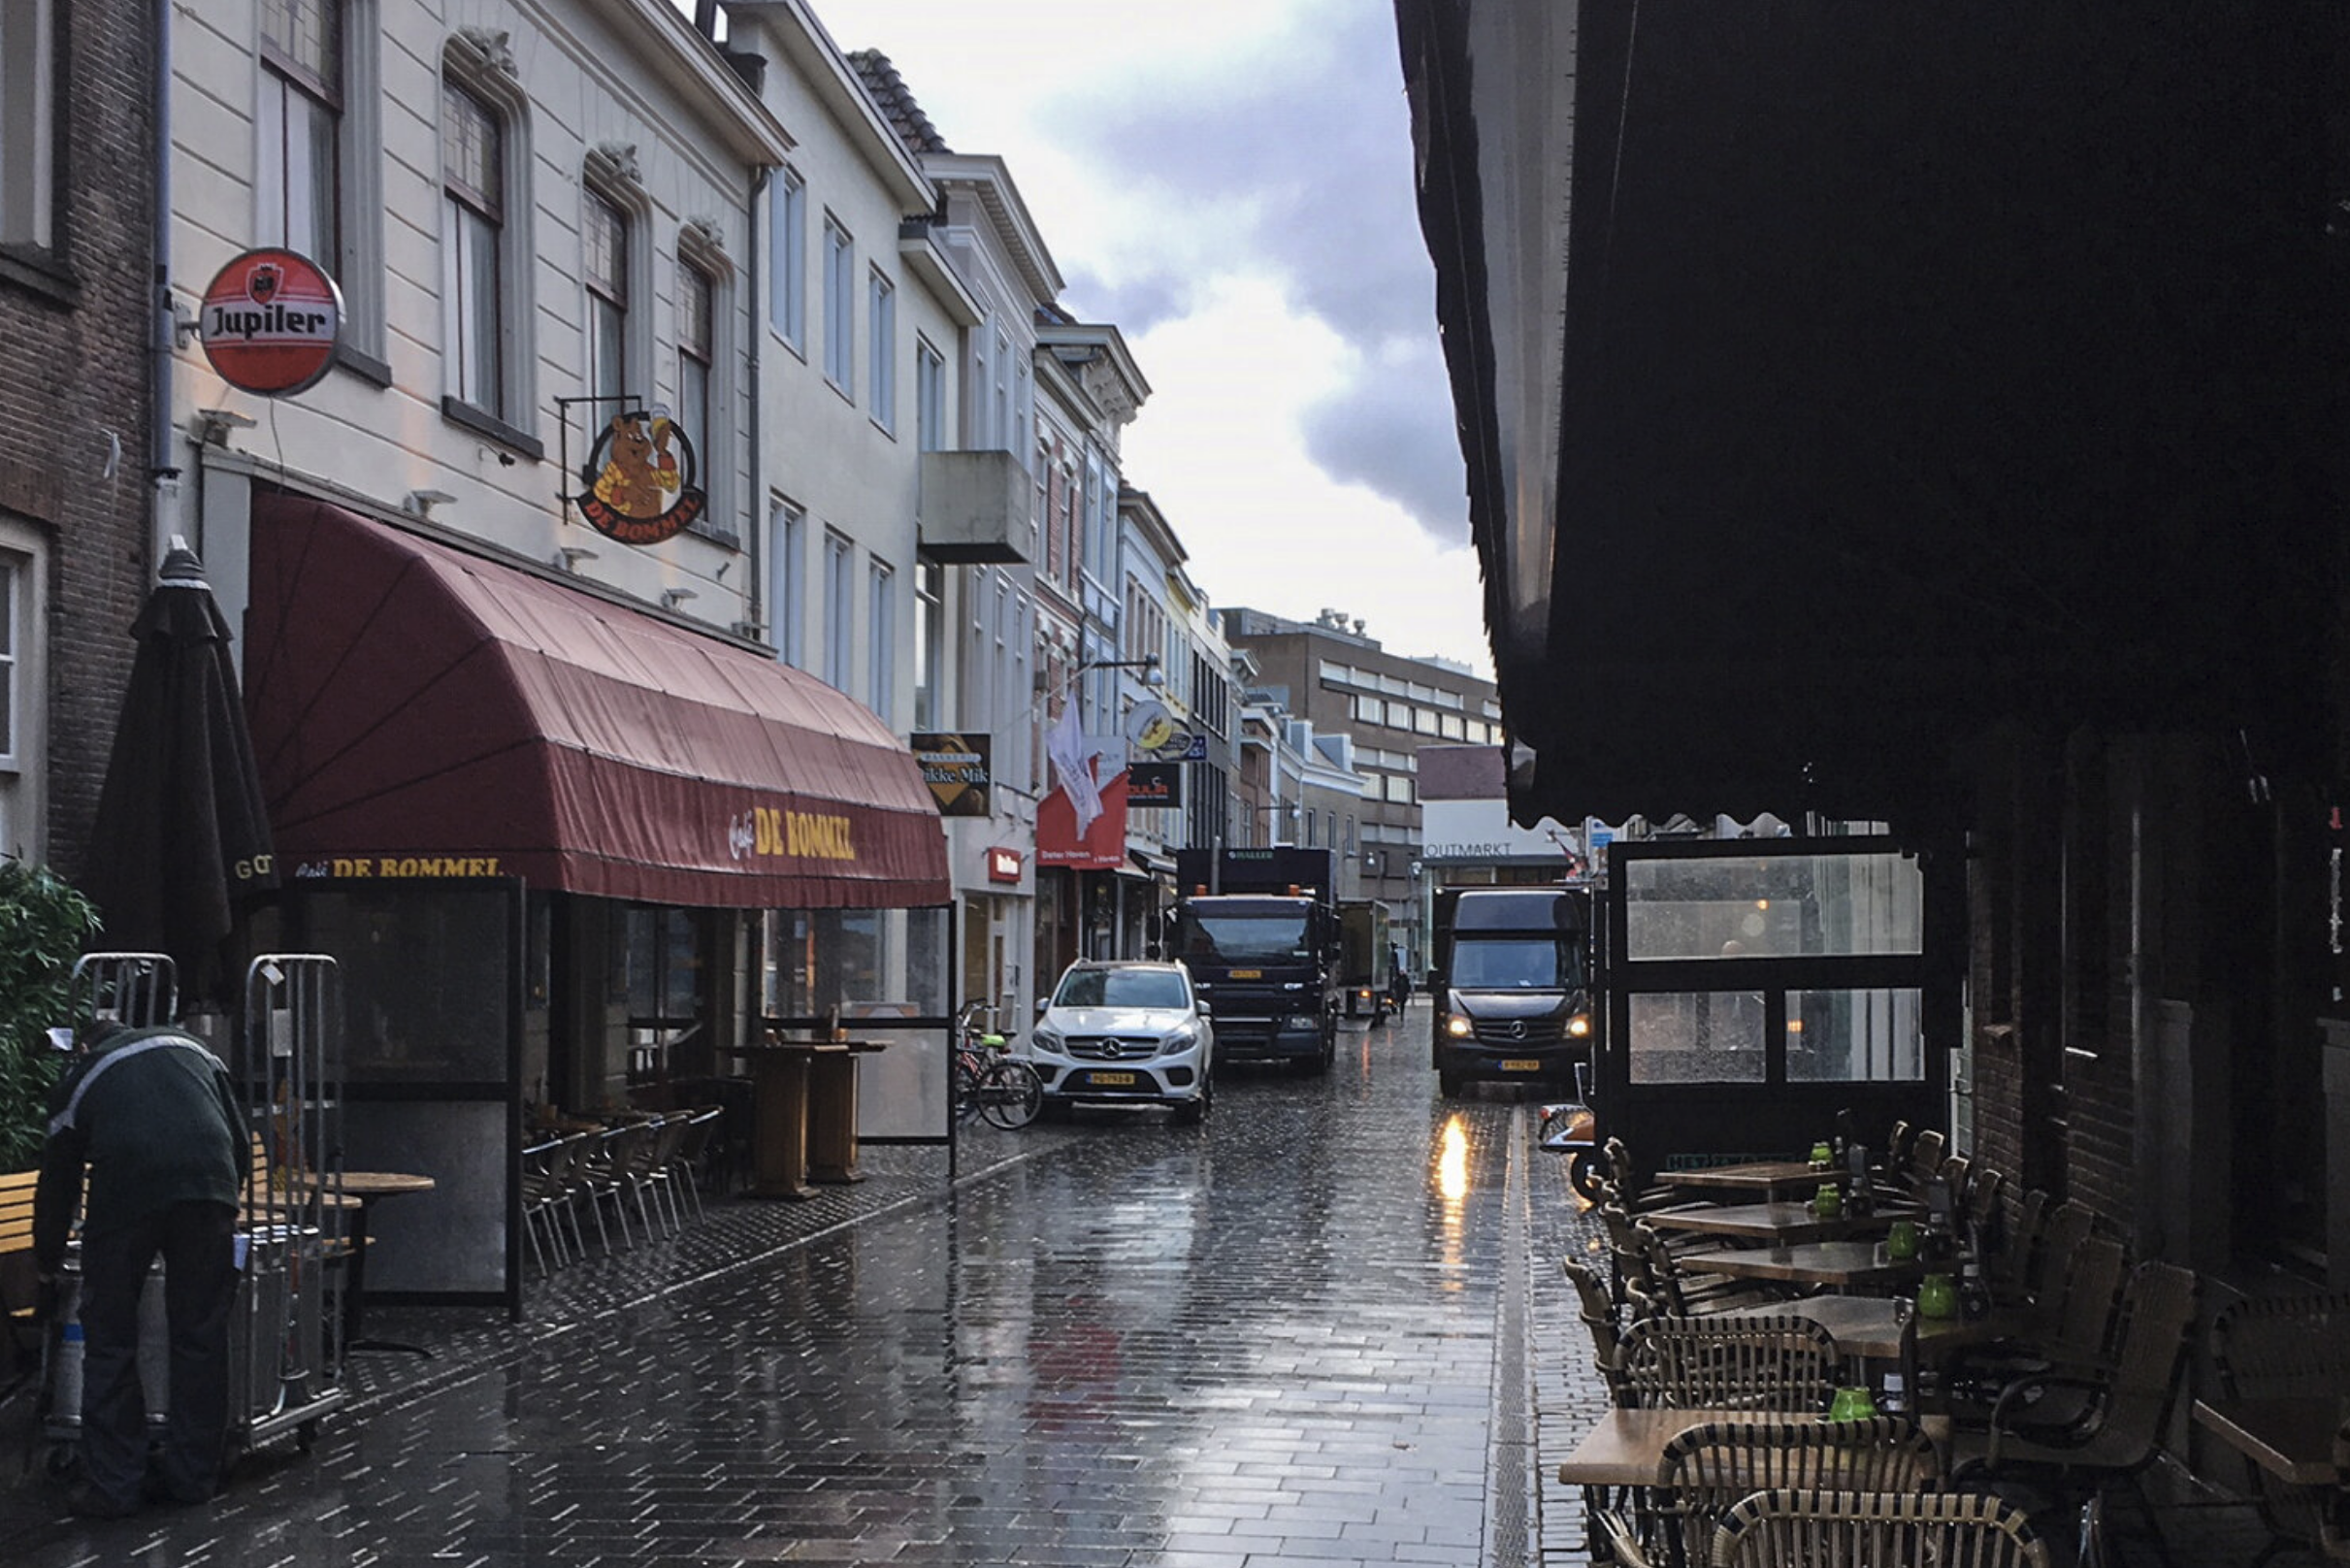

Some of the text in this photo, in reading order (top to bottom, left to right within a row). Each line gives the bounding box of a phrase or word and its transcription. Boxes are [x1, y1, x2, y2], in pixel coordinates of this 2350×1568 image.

[211, 304, 326, 341] Jupiler
[920, 767, 990, 783] ikke Mik
[754, 806, 784, 856] DE
[333, 858, 373, 877] DE
[379, 858, 505, 877] BOMMEL
